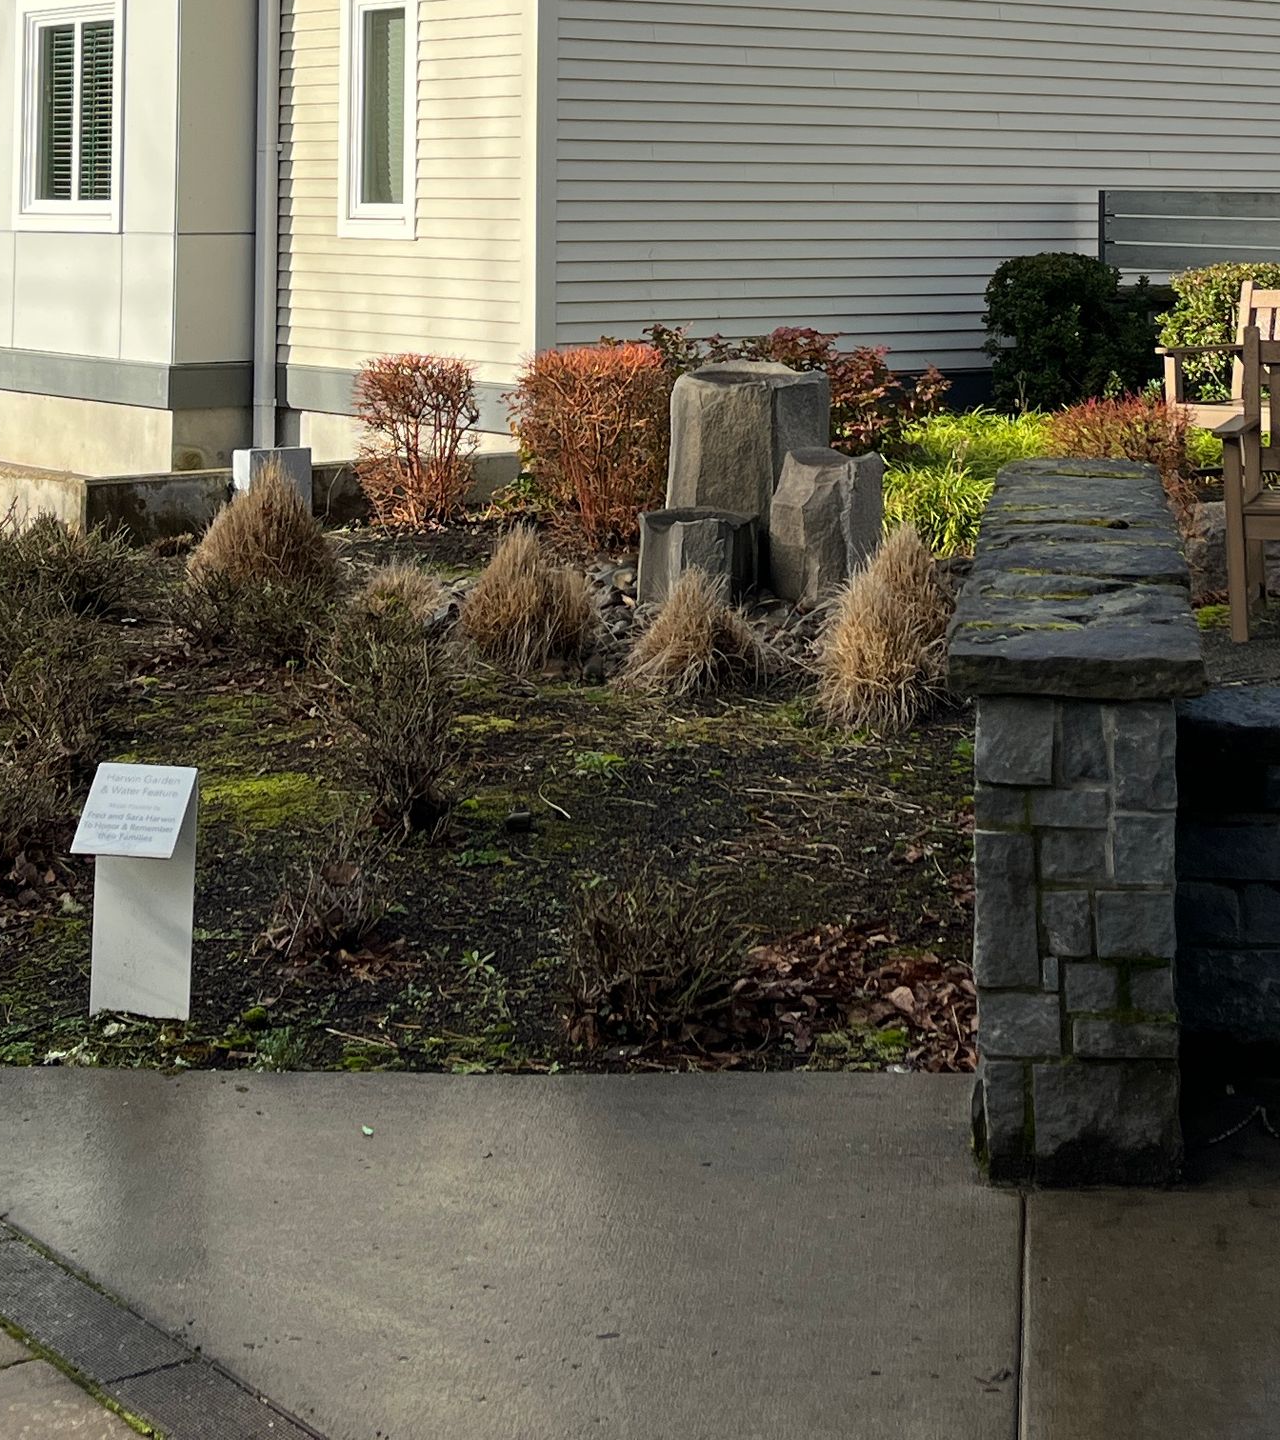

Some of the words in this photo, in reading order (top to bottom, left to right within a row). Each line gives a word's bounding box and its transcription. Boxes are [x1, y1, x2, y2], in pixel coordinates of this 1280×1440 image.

[144, 774, 181, 785] Garden
[100, 785, 108, 794] &
[111, 785, 140, 795] Water
[142, 786, 179, 798] Feature
[125, 812, 144, 822] Sara
[83, 820, 93, 829] To
[129, 823, 174, 833] Remember
[118, 832, 153, 842] Families
